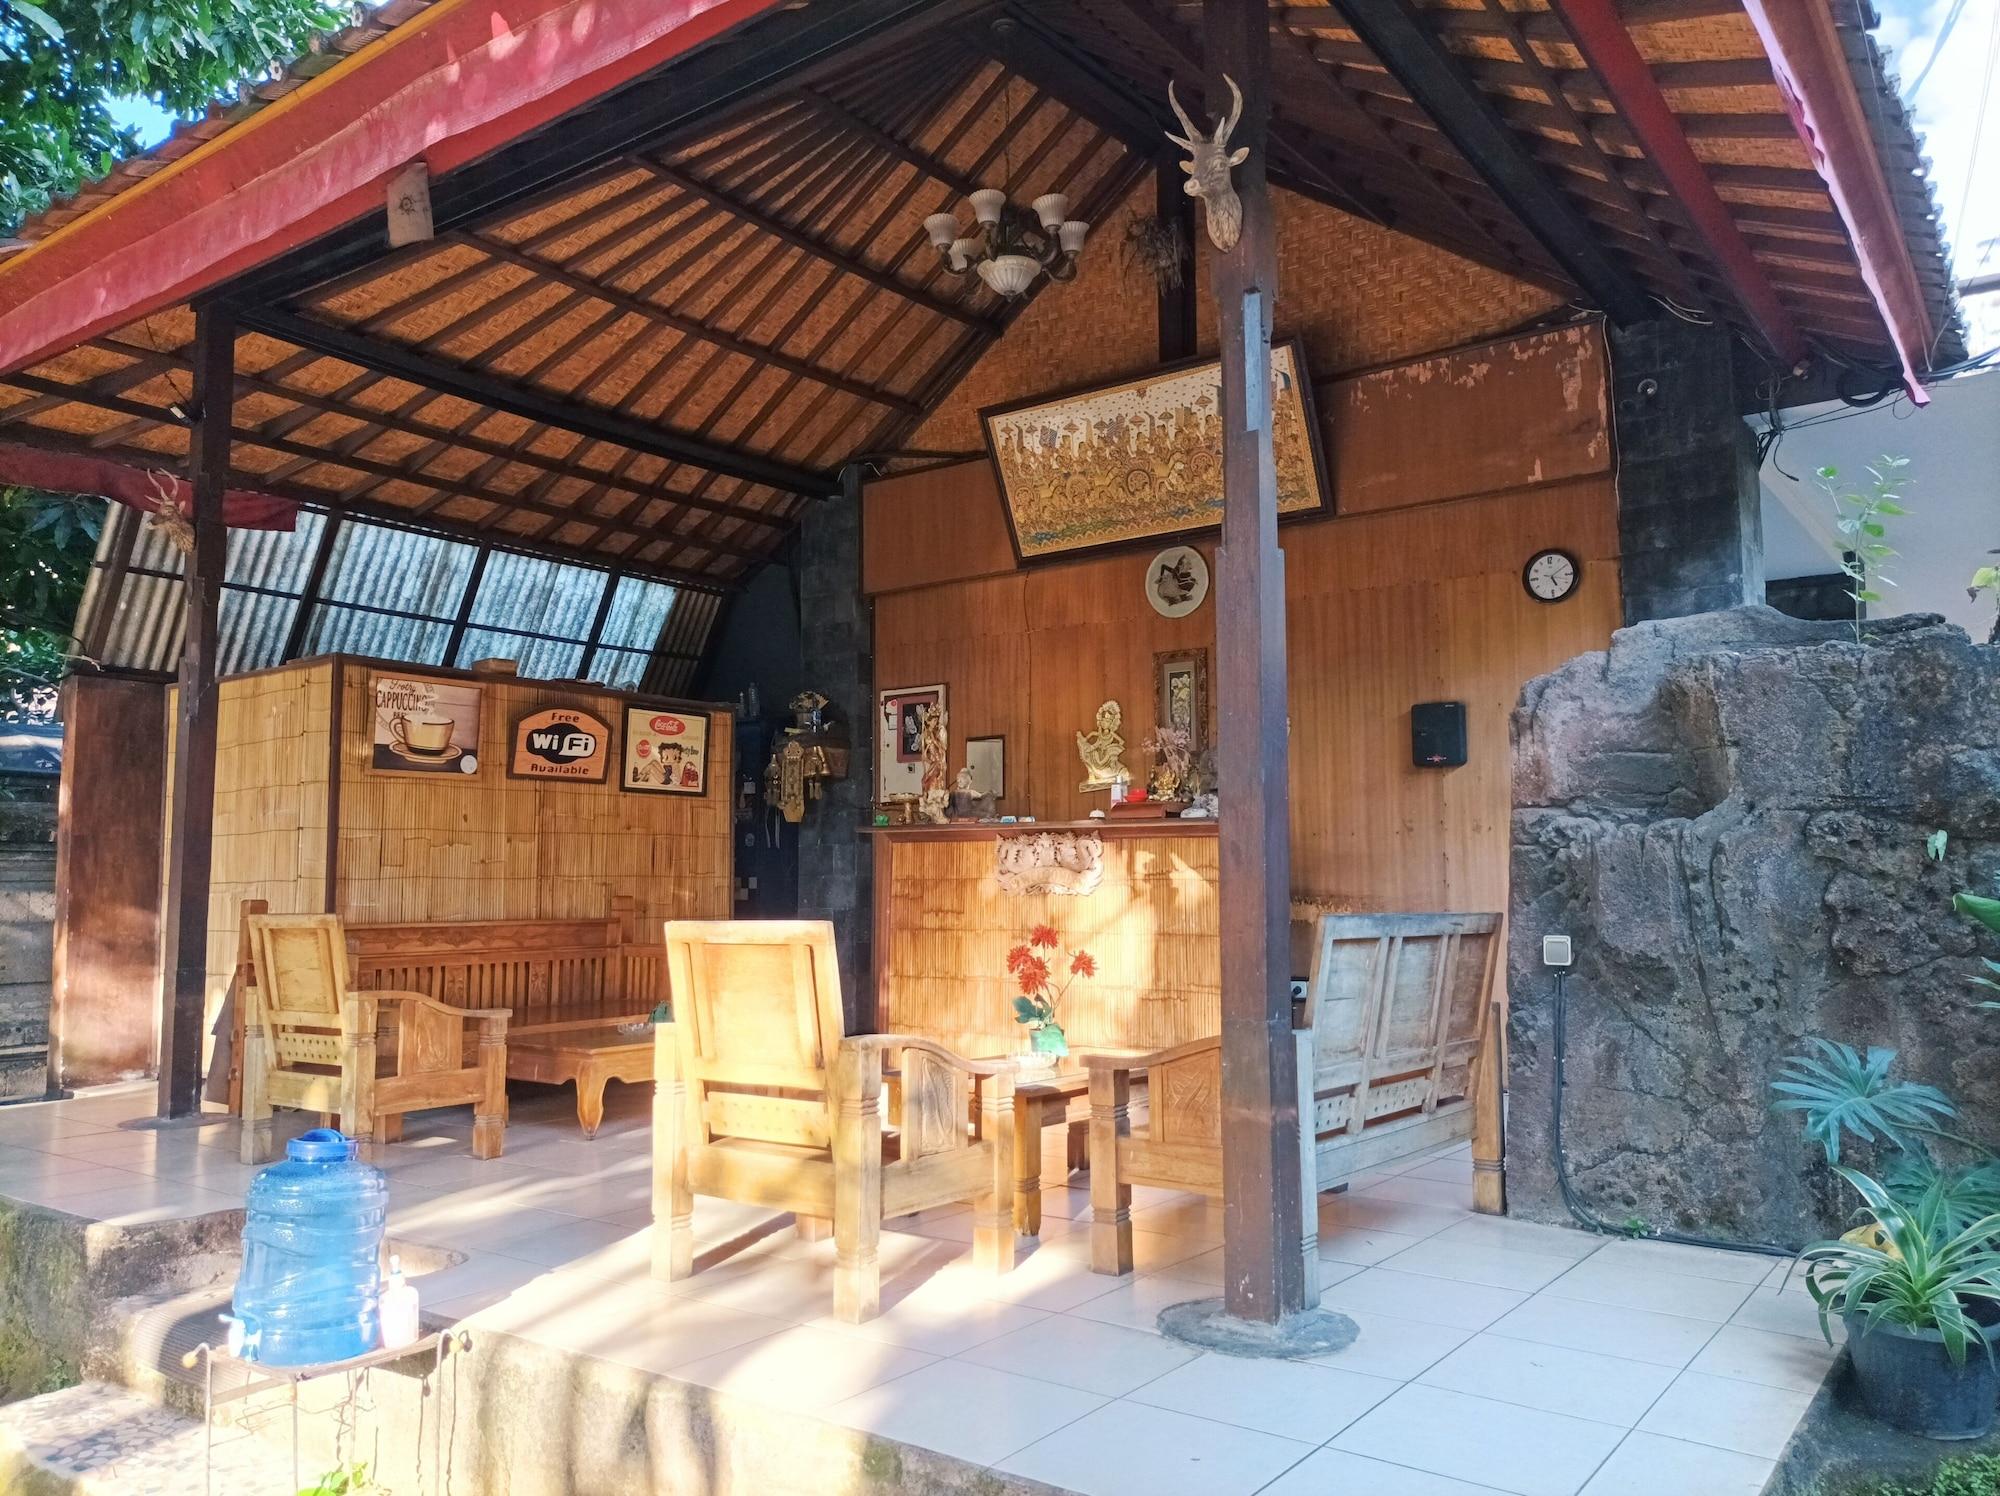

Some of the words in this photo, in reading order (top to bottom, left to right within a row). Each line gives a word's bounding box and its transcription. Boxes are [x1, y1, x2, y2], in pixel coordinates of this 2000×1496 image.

[376, 690, 428, 712] CAPPUCCINO
[551, 712, 580, 723] Free
[530, 763, 590, 775] Available
